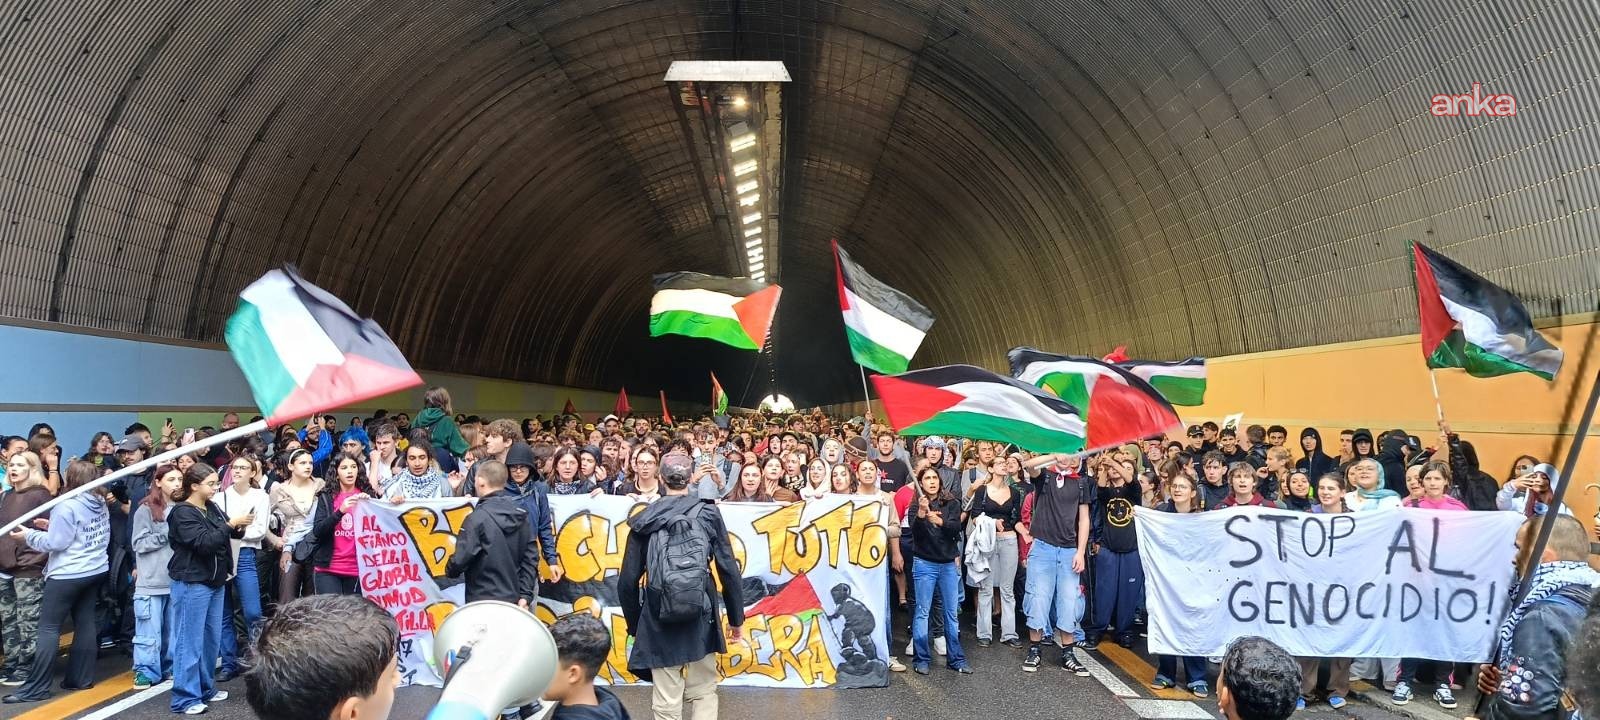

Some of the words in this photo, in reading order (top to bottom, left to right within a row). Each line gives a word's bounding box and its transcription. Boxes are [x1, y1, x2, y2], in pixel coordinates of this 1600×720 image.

[362, 515, 382, 532] AL
[752, 500, 887, 576] TUTTO
[362, 549, 410, 567] DELLA
[1224, 514, 1356, 568] STOP
[1385, 517, 1476, 580] AL
[362, 563, 423, 591] GLOBAL
[1228, 580, 1495, 629] GENOCIDIO!
